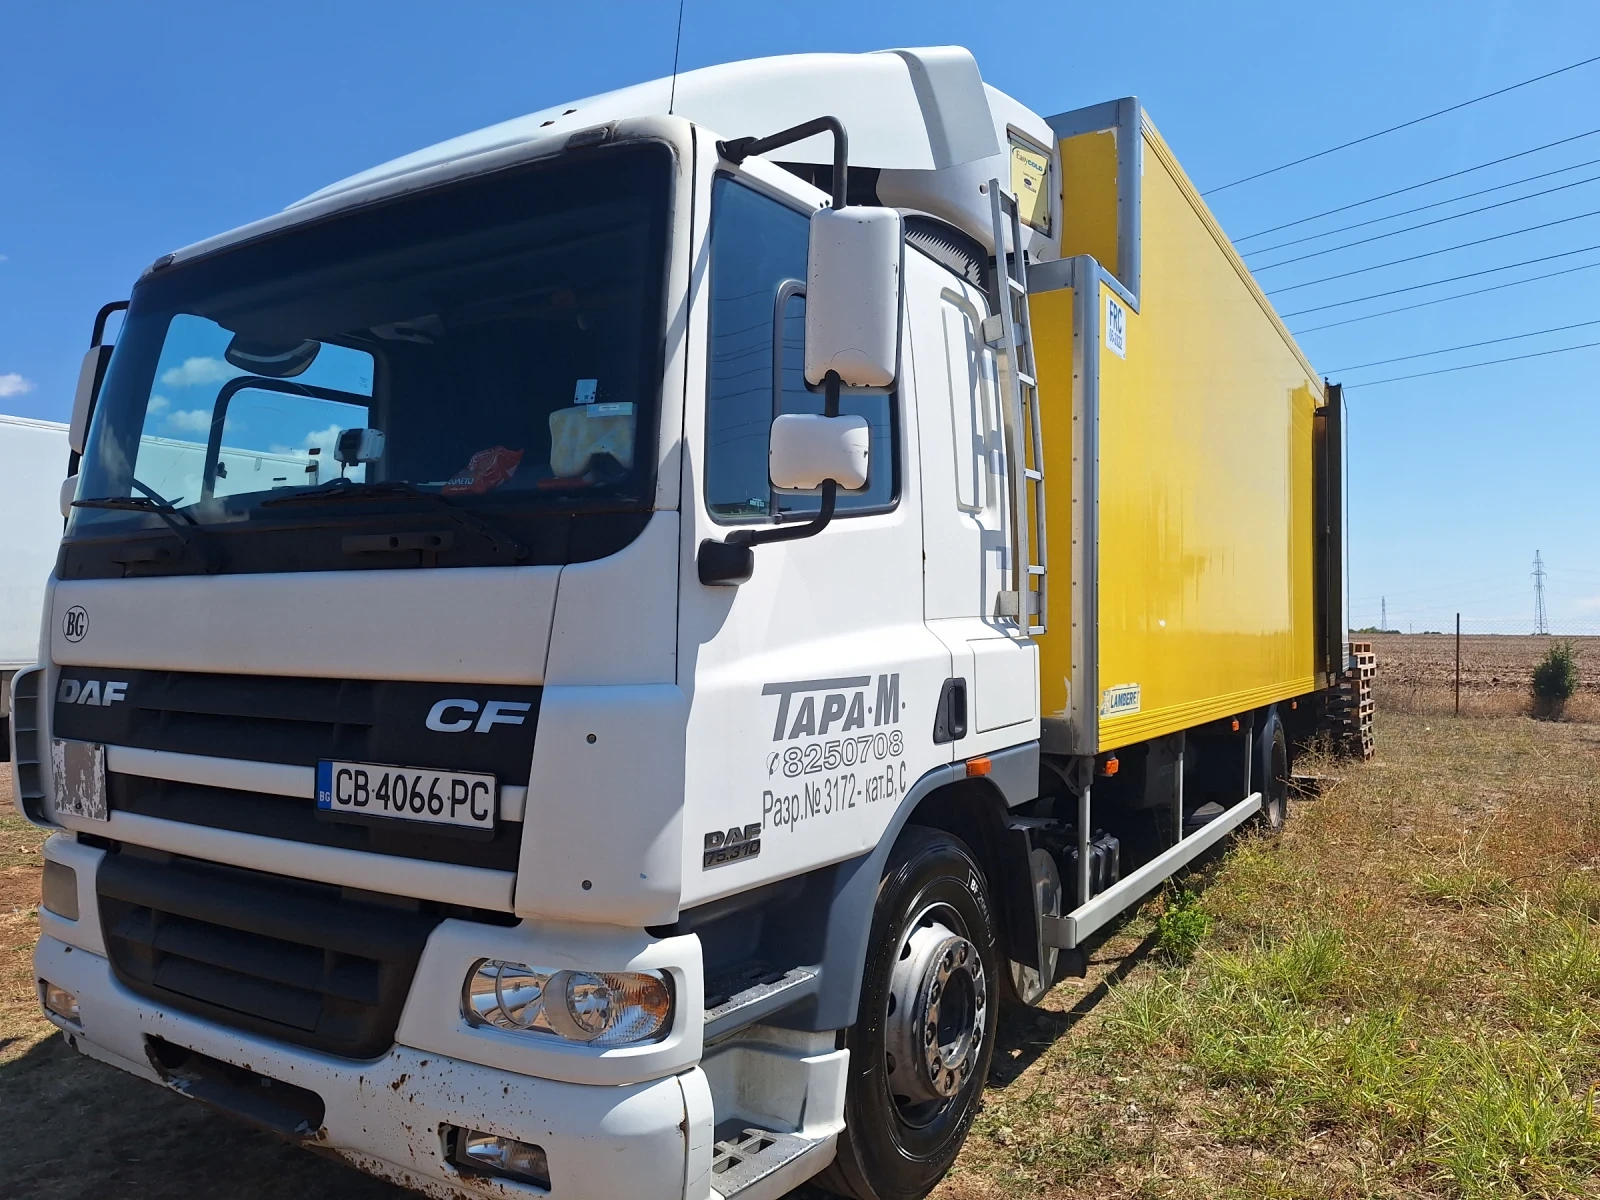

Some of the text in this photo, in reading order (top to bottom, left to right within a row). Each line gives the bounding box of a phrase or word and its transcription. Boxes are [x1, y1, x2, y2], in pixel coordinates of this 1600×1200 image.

[1109, 300, 1122, 334] FRC
[66, 611, 84, 637] BG
[58, 679, 128, 707] DAF
[426, 698, 532, 734] CF
[783, 730, 904, 778] 8250708
[319, 790, 331, 802] BG
[824, 773, 856, 815] 3172
[704, 822, 762, 849] DAF
